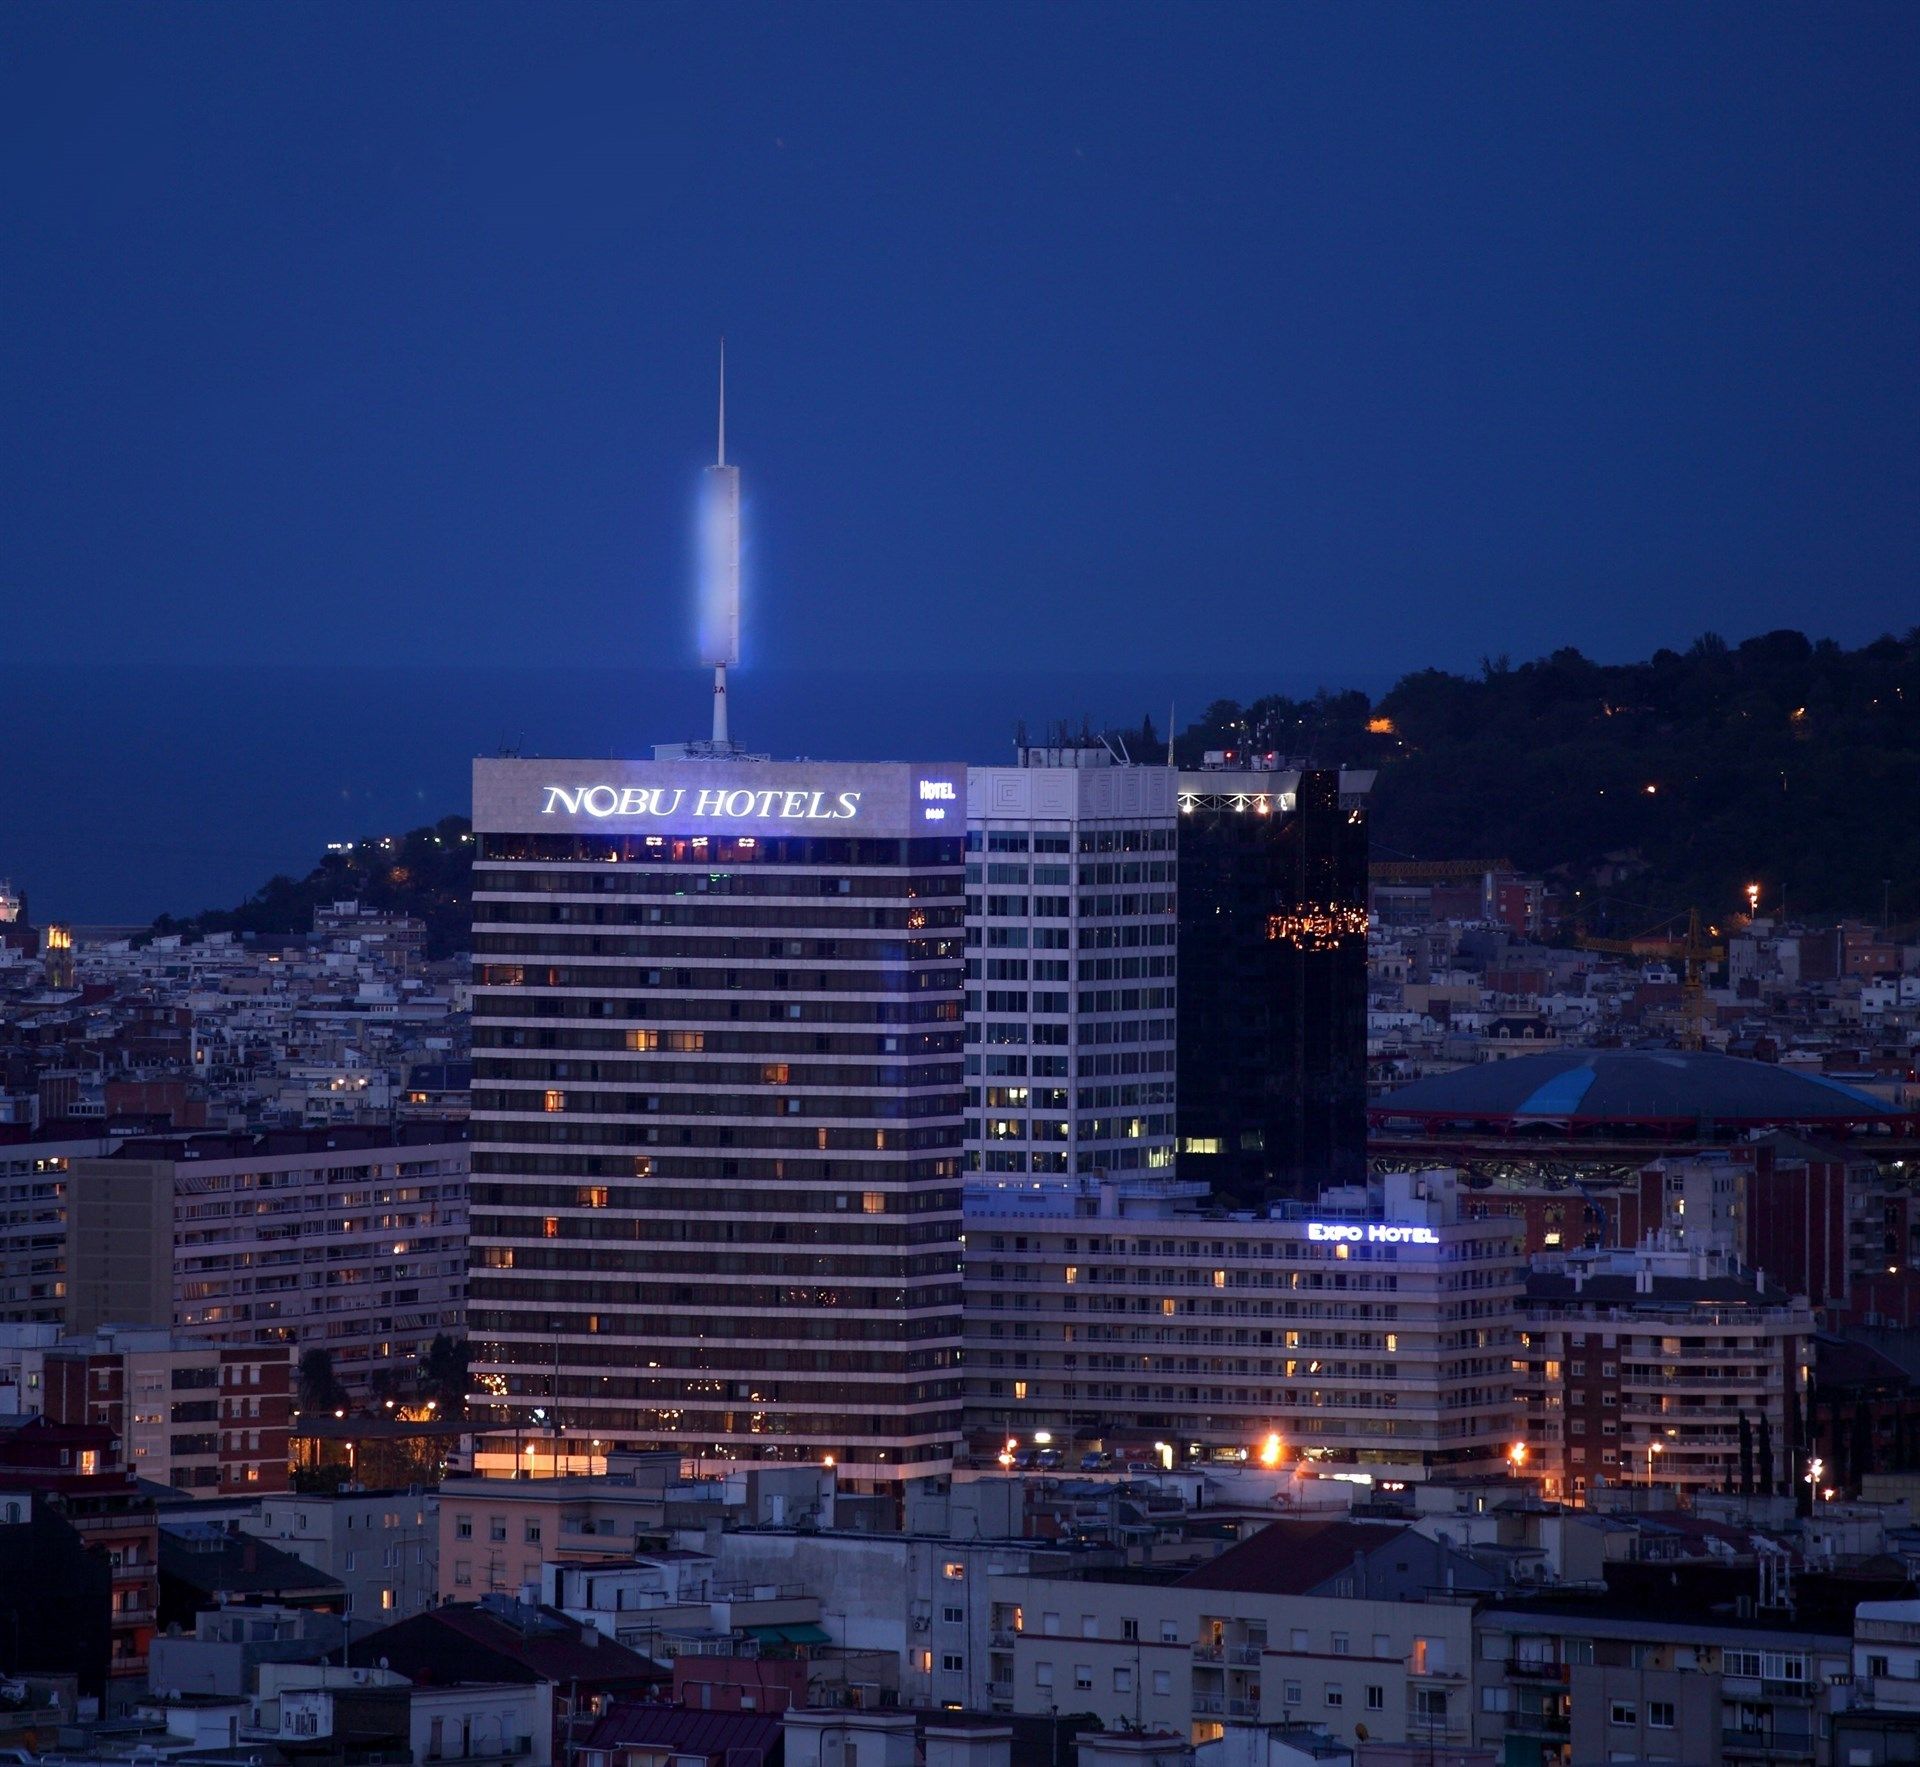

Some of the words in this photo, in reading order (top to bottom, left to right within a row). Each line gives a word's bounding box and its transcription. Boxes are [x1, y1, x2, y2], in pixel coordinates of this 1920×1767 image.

[919, 780, 956, 800] HOTEL
[541, 784, 687, 819] NOBU
[692, 789, 862, 819] HOTELS
[1308, 1223, 1363, 1242] EXPO
[1368, 1225, 1440, 1244] HOTEL
